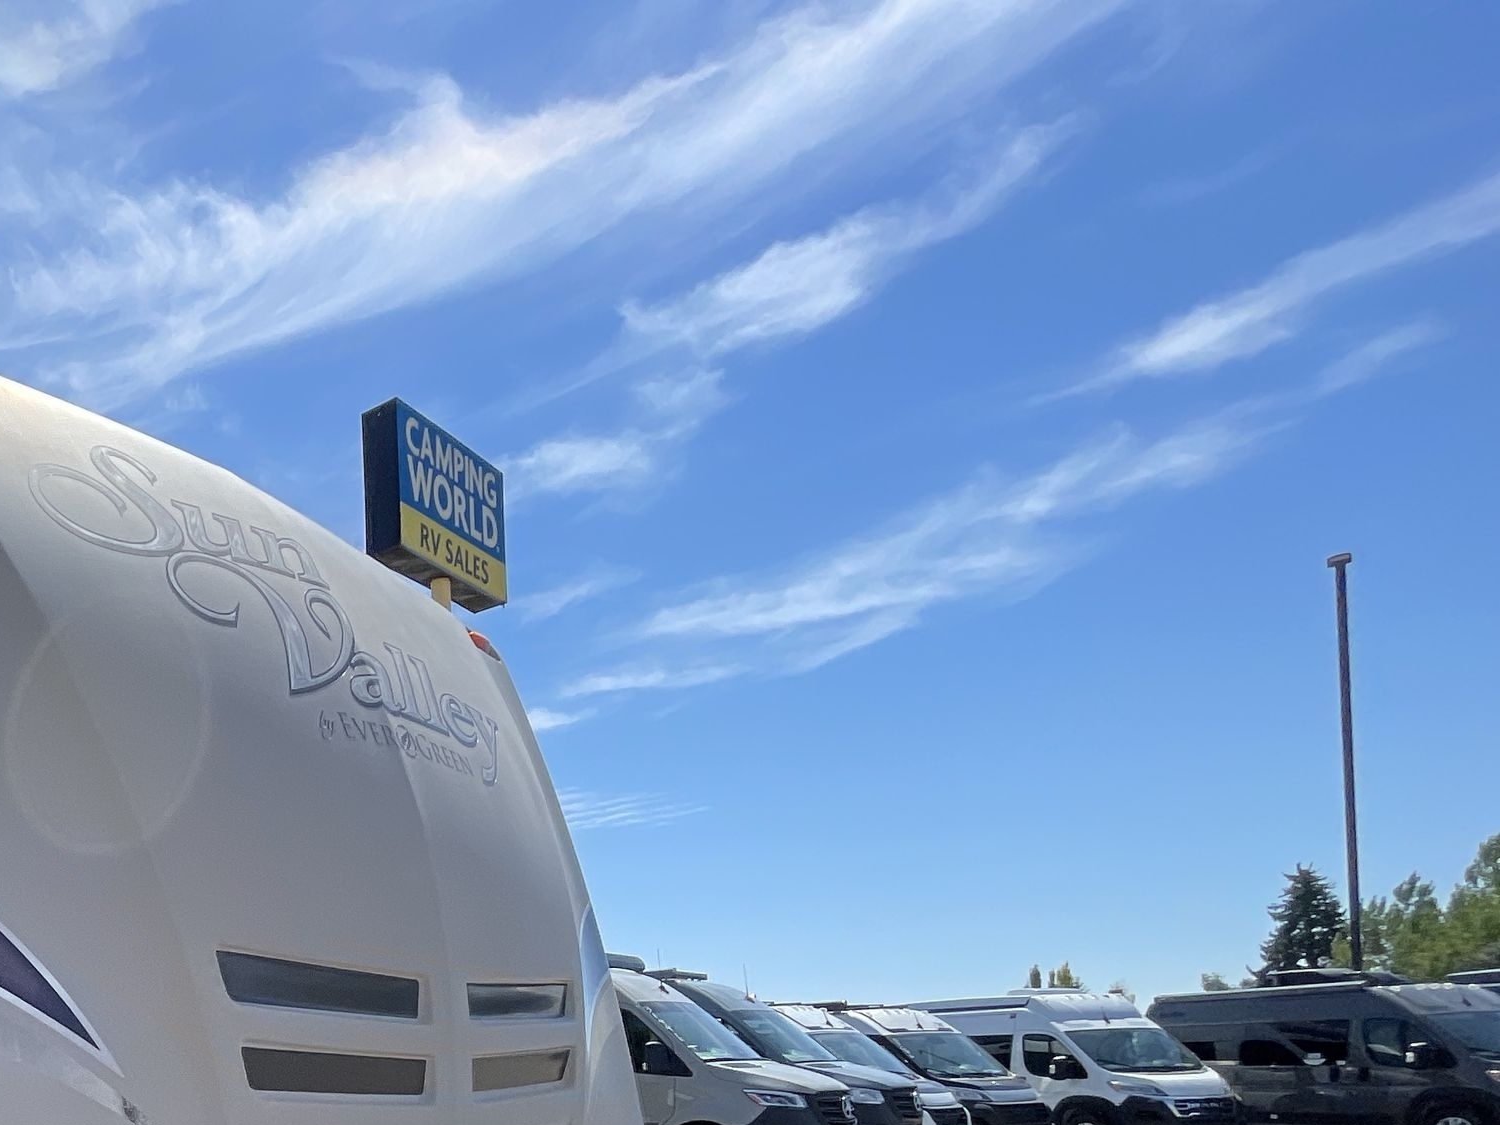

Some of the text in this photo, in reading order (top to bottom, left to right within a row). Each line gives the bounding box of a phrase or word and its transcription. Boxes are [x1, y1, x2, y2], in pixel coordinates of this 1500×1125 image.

[405, 416, 498, 509] CAMPING
[406, 453, 499, 549] WORLD
[27, 445, 330, 590] Sun
[420, 522, 489, 585] RV SALES
[166, 550, 499, 787] Valley
